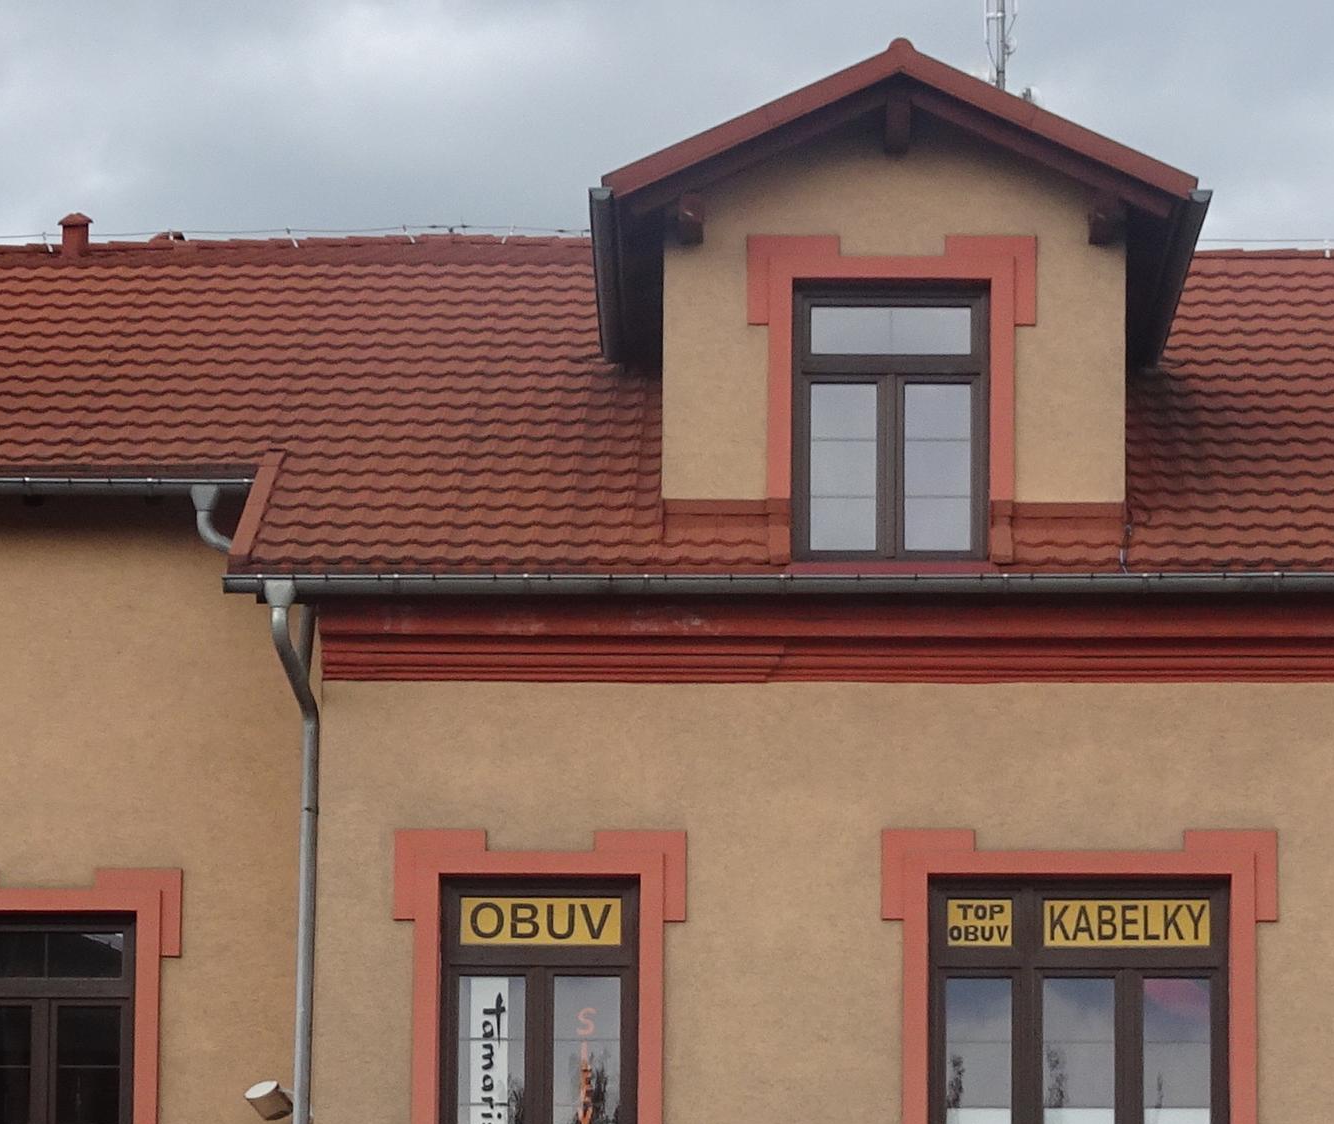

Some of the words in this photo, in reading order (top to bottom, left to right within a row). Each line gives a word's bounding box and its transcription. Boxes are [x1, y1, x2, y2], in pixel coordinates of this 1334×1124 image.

[470, 902, 612, 940] OBUV
[957, 904, 1004, 921] TOP
[1049, 904, 1205, 941] KABELKY
[949, 925, 1008, 941] OBUV
